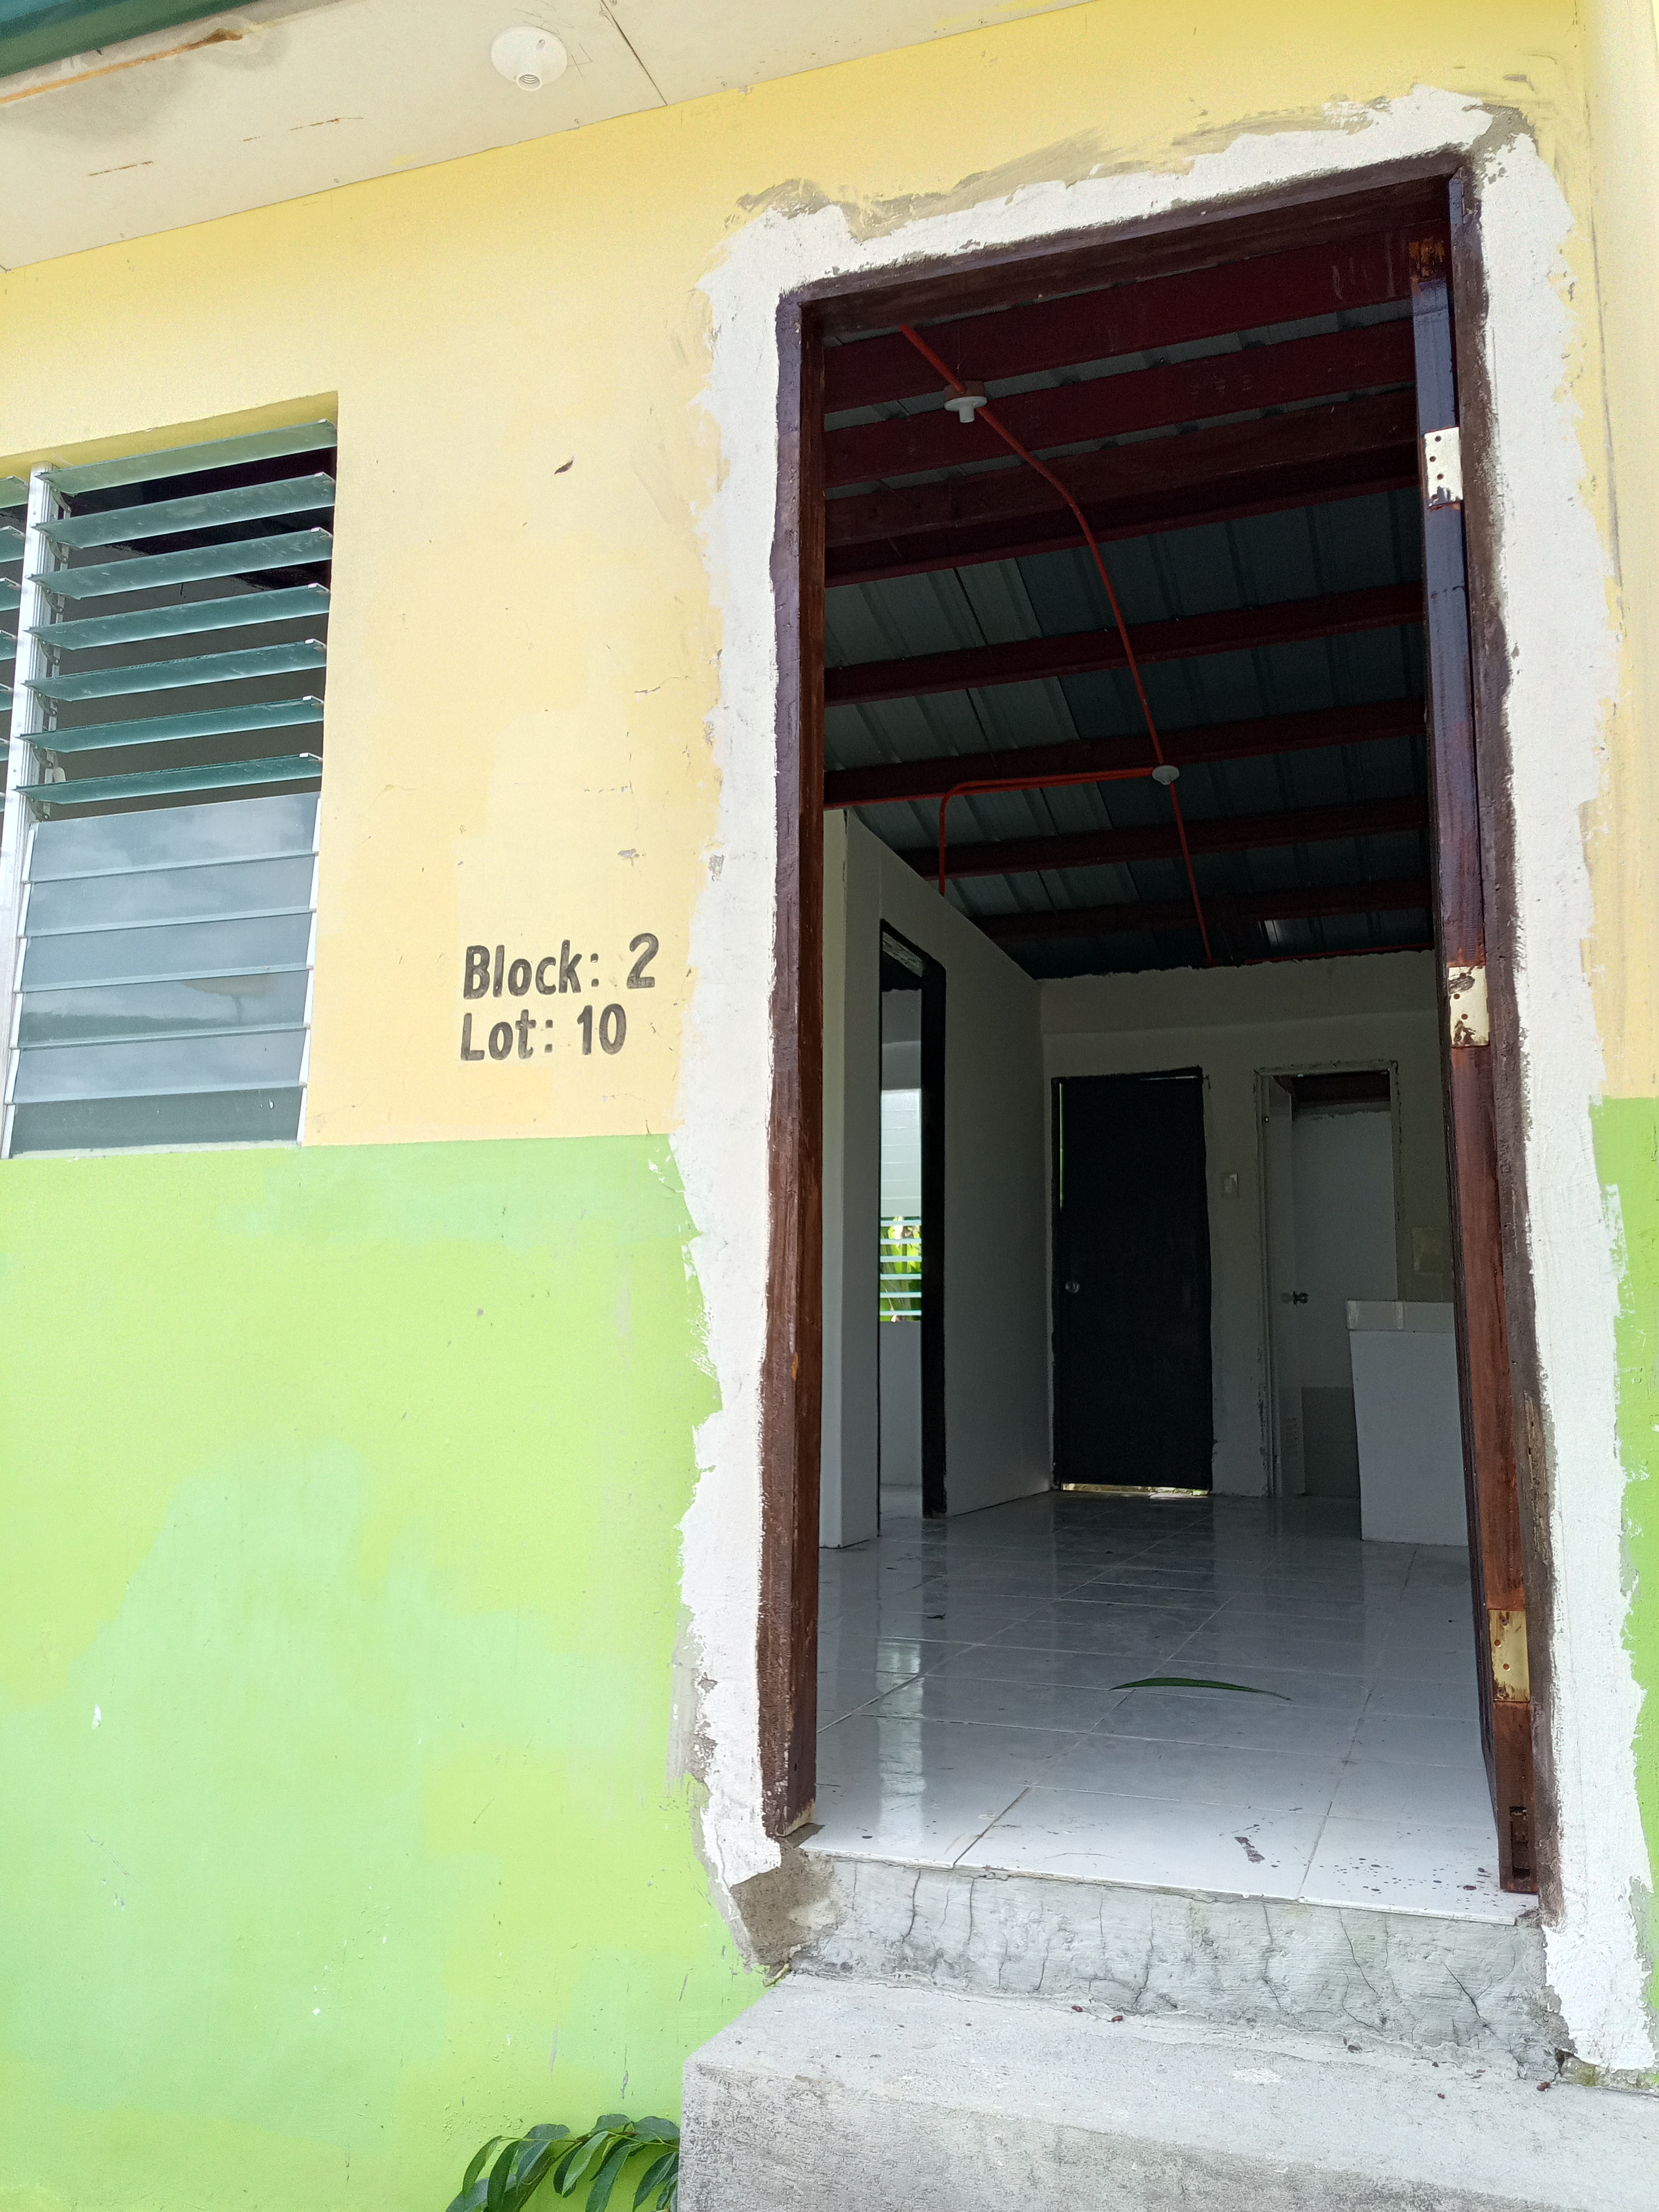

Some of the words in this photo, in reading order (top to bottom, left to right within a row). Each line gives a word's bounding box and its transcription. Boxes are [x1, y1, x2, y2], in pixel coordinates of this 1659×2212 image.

[463, 940, 599, 999] Block:
[626, 933, 659, 989] 2
[460, 1009, 554, 1061] Lot:
[577, 1003, 626, 1055] 10
